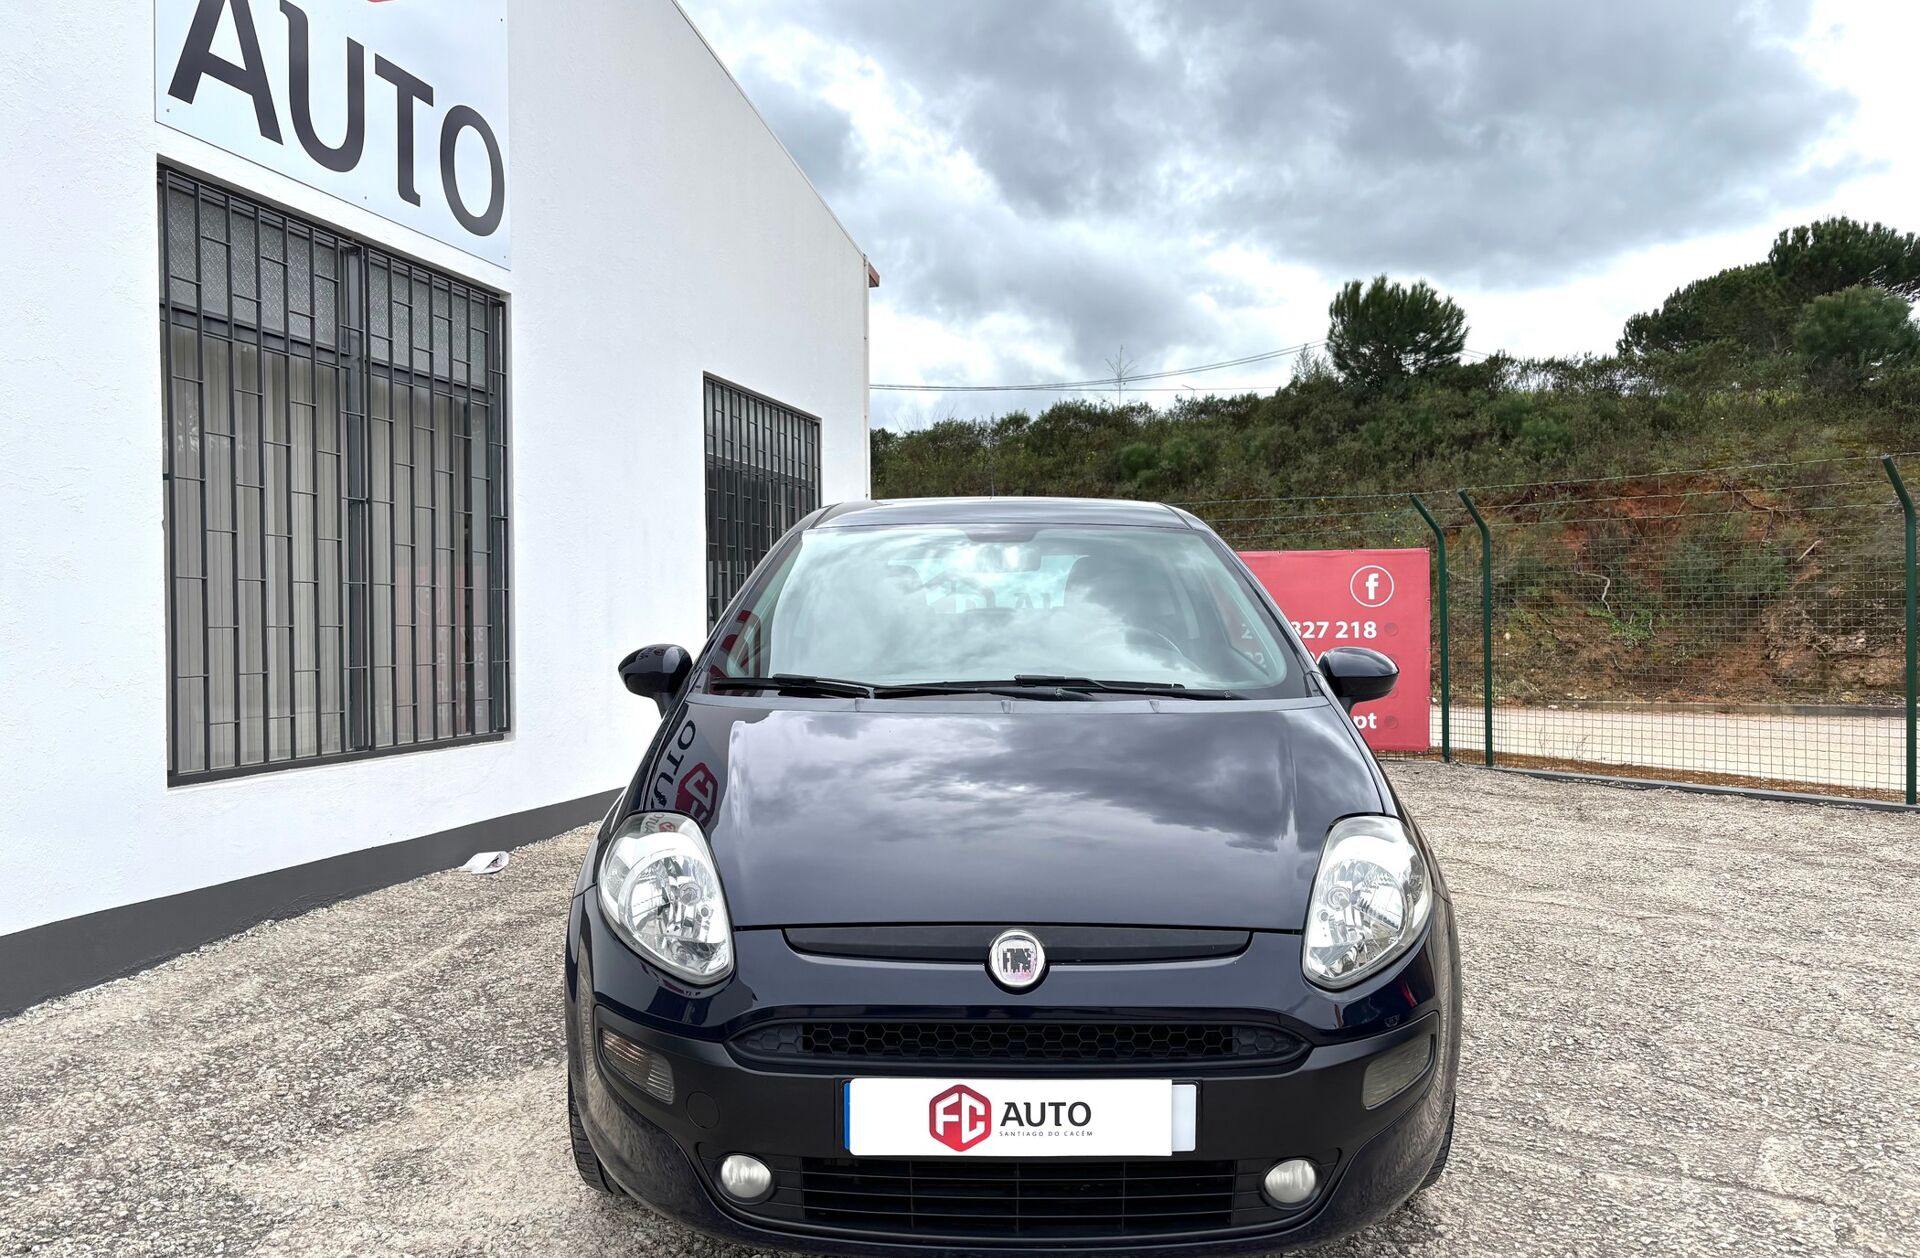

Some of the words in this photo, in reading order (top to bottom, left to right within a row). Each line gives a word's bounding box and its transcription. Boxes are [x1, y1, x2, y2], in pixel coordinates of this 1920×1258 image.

[167, 0, 505, 237] AUTO
[1335, 620, 1377, 639] 218
[935, 1092, 986, 1144] FC
[1000, 1101, 1092, 1127] AUTO
